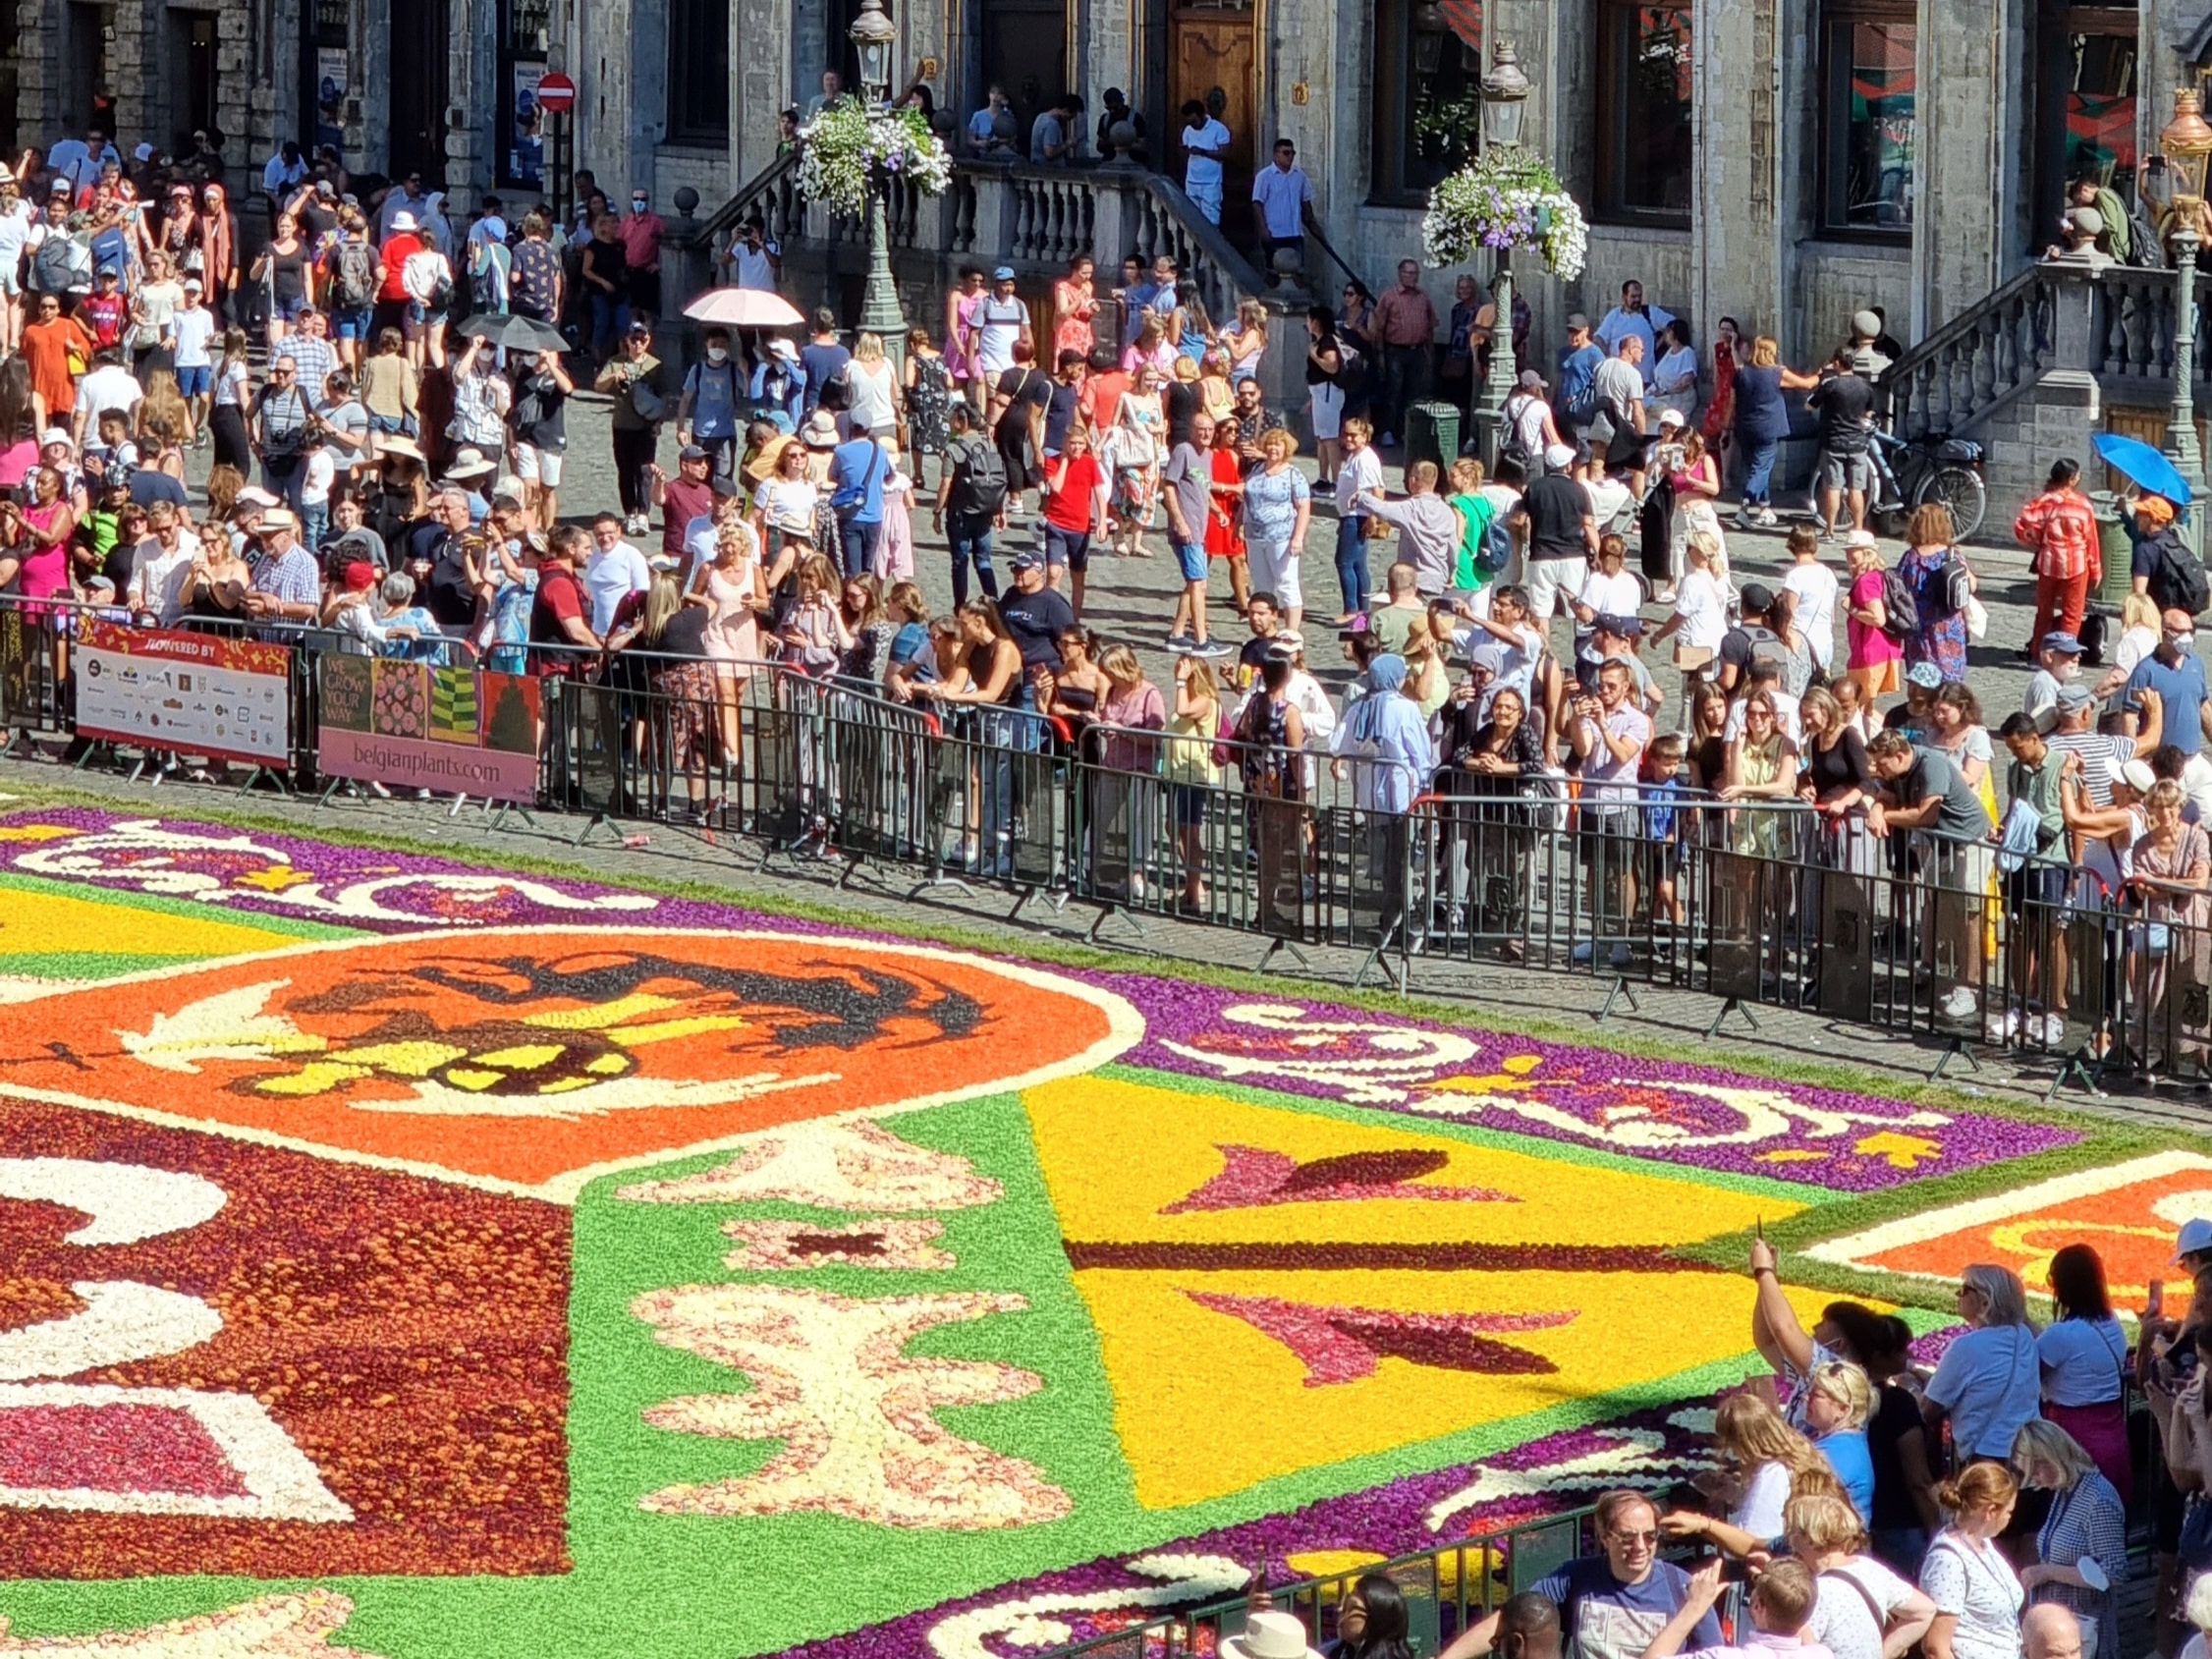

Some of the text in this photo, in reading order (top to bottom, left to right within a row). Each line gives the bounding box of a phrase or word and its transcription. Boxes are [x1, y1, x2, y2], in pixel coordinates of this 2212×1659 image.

[144, 638, 215, 658] FLOWERED BY
[326, 658, 345, 674] WE
[325, 674, 364, 692] GROW
[326, 691, 359, 708] YOUR
[326, 705, 353, 723] WAY
[354, 743, 501, 782] belgianplants.com
